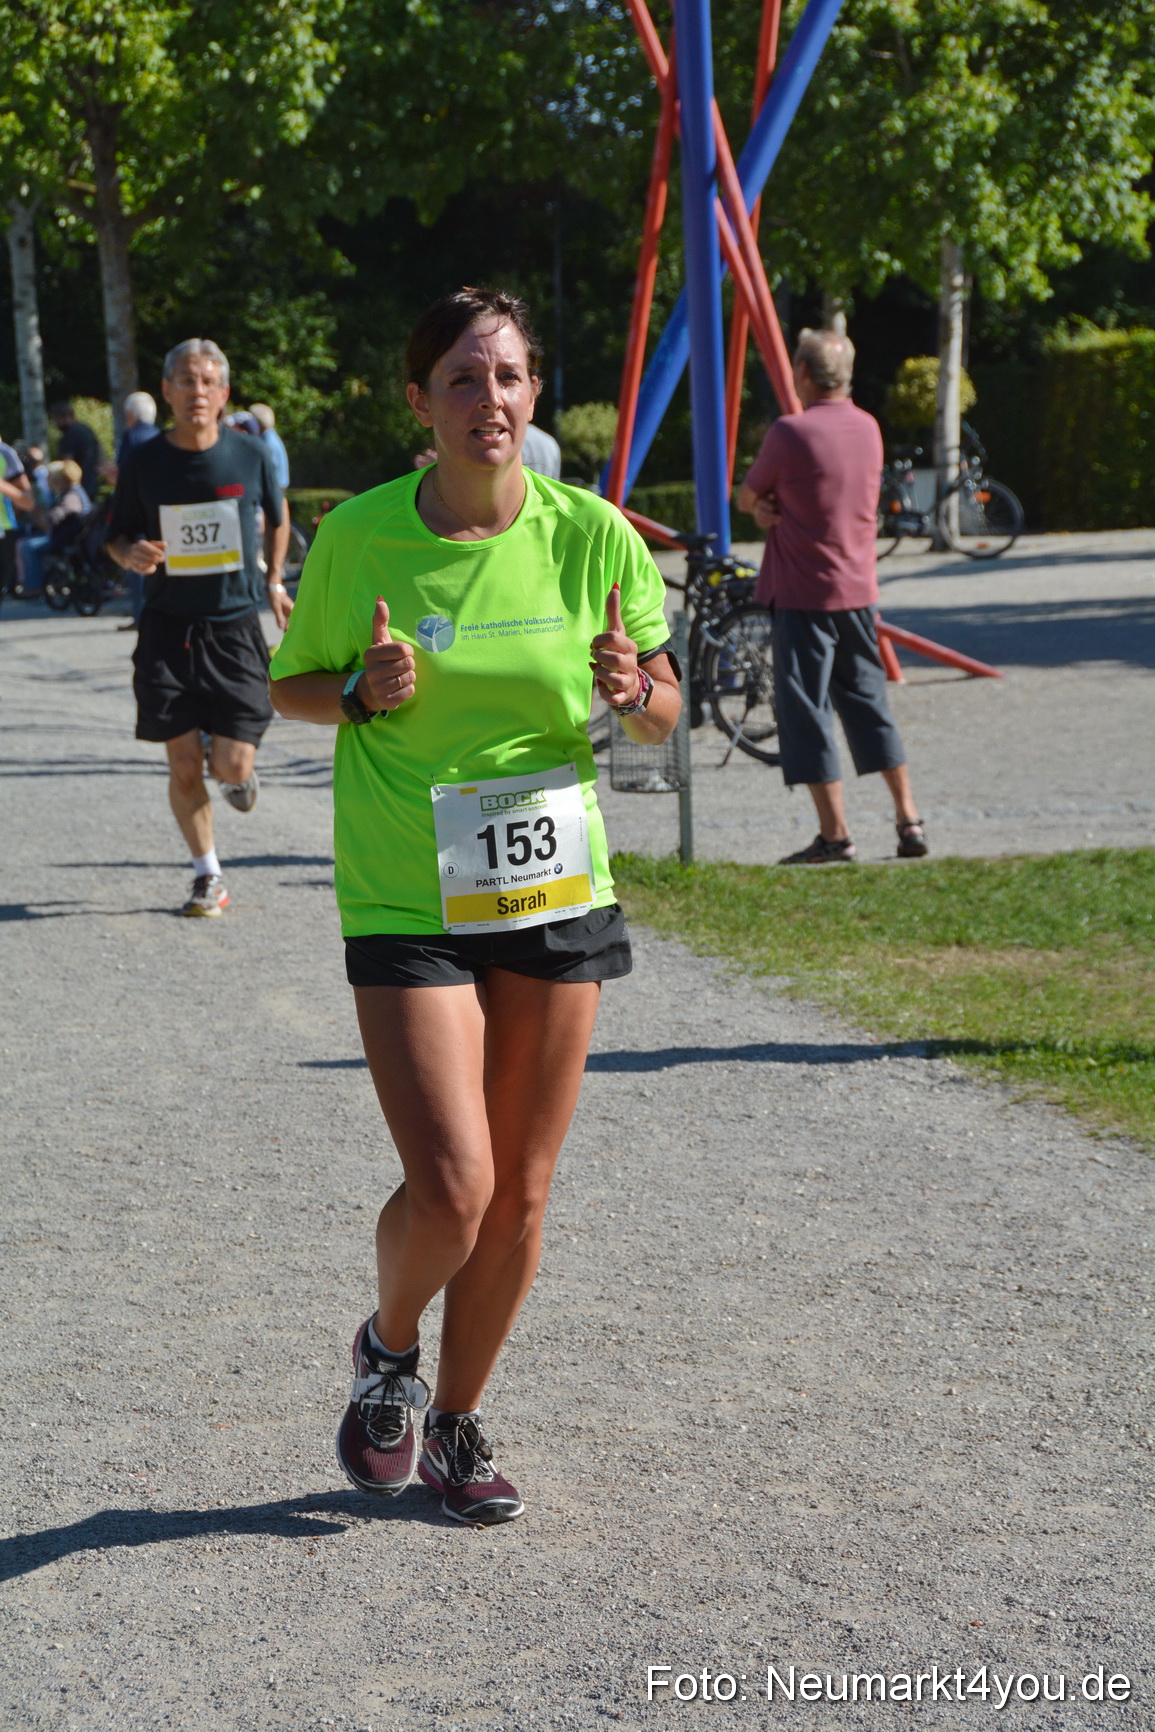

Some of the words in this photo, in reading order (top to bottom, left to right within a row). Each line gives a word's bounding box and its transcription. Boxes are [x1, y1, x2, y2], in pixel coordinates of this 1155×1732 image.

[181, 522, 221, 545] 337
[460, 624, 479, 632] Freie
[480, 619, 523, 630] katholische
[524, 616, 564, 625] Volksschule
[471, 632, 487, 640] Haus
[488, 630, 497, 639] St.
[498, 629, 523, 638] Marien,
[480, 787, 547, 811] BOCK
[481, 809, 504, 818] inspired
[477, 815, 557, 870] 153
[448, 866, 454, 875] D
[475, 877, 509, 888] PARTL
[510, 868, 552, 884] Neumarkt
[497, 890, 547, 916] Sarah
